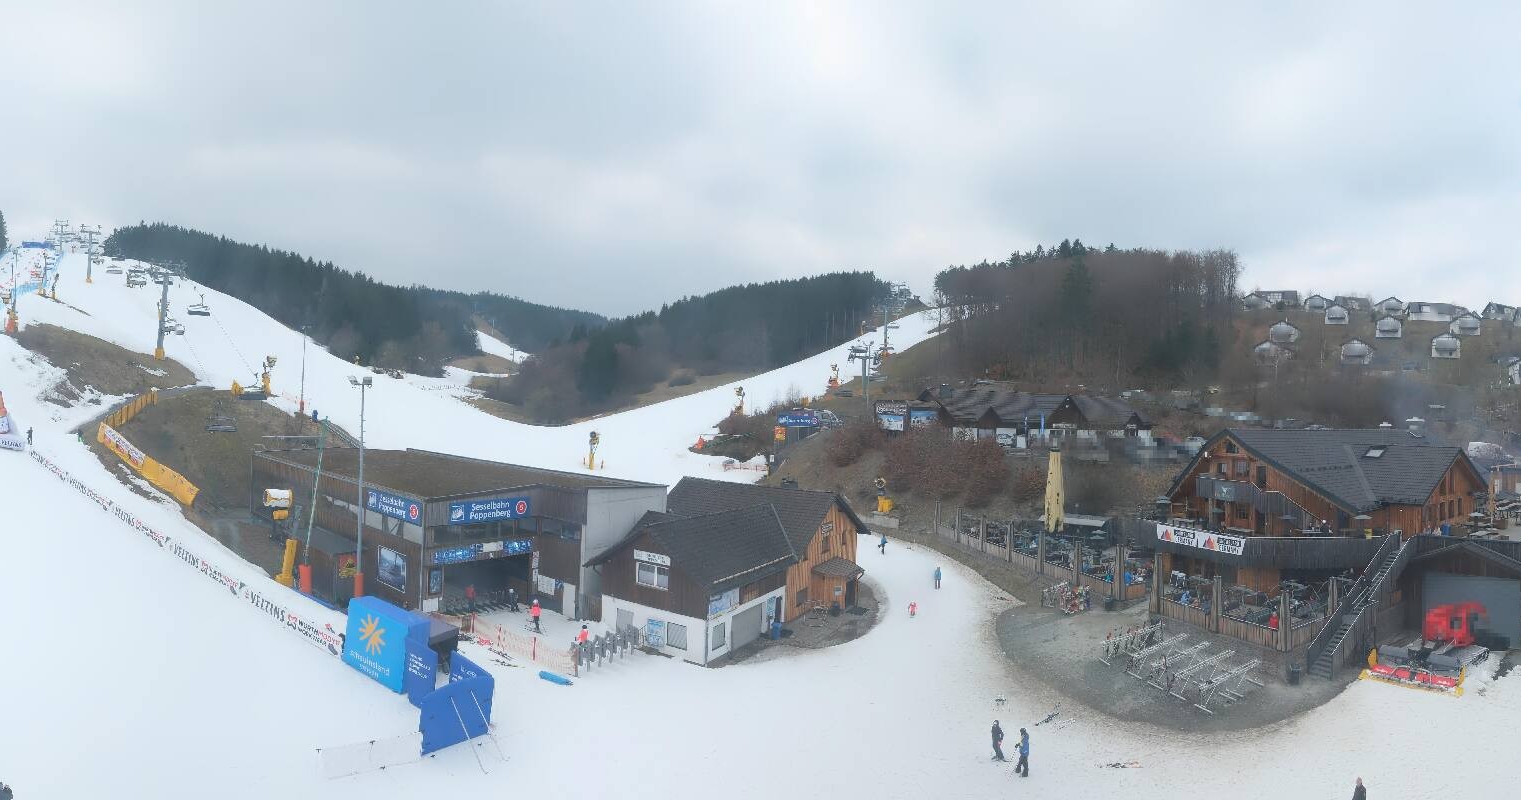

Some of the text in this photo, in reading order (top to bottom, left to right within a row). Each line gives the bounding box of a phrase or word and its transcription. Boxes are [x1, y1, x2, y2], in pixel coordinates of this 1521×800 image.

[469, 509, 511, 521] Poppenberg
[471, 501, 510, 512] Sesselbahn
[173, 543, 199, 568] VELTINS
[250, 590, 286, 622] VELTINS
[349, 649, 390, 677] schauinsland
